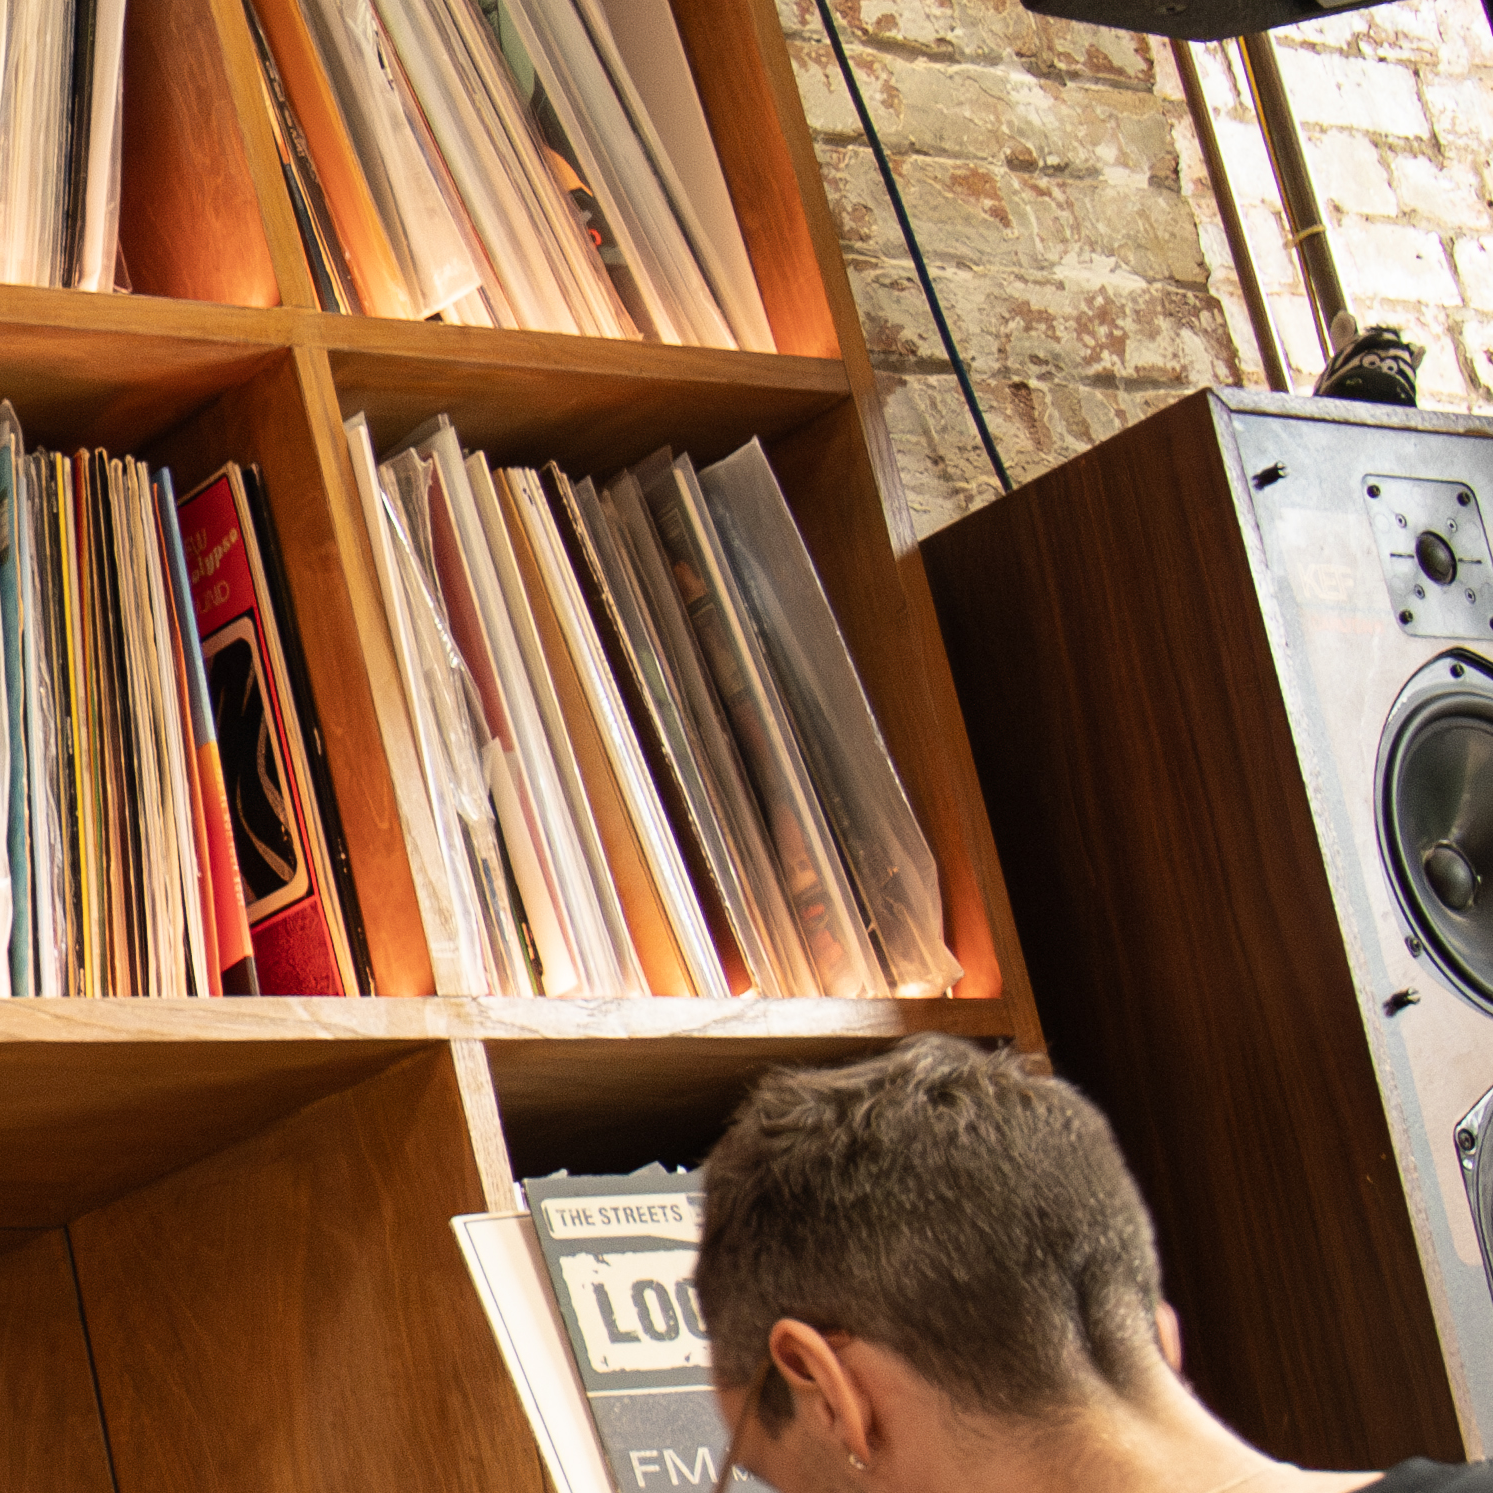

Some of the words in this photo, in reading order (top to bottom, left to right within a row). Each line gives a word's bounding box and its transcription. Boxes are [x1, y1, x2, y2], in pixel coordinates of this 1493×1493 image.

[1296, 562, 1354, 601] KEF
[555, 1208, 596, 1228] THE
[598, 1204, 683, 1227] STREETS
[629, 1447, 718, 1488] FM
